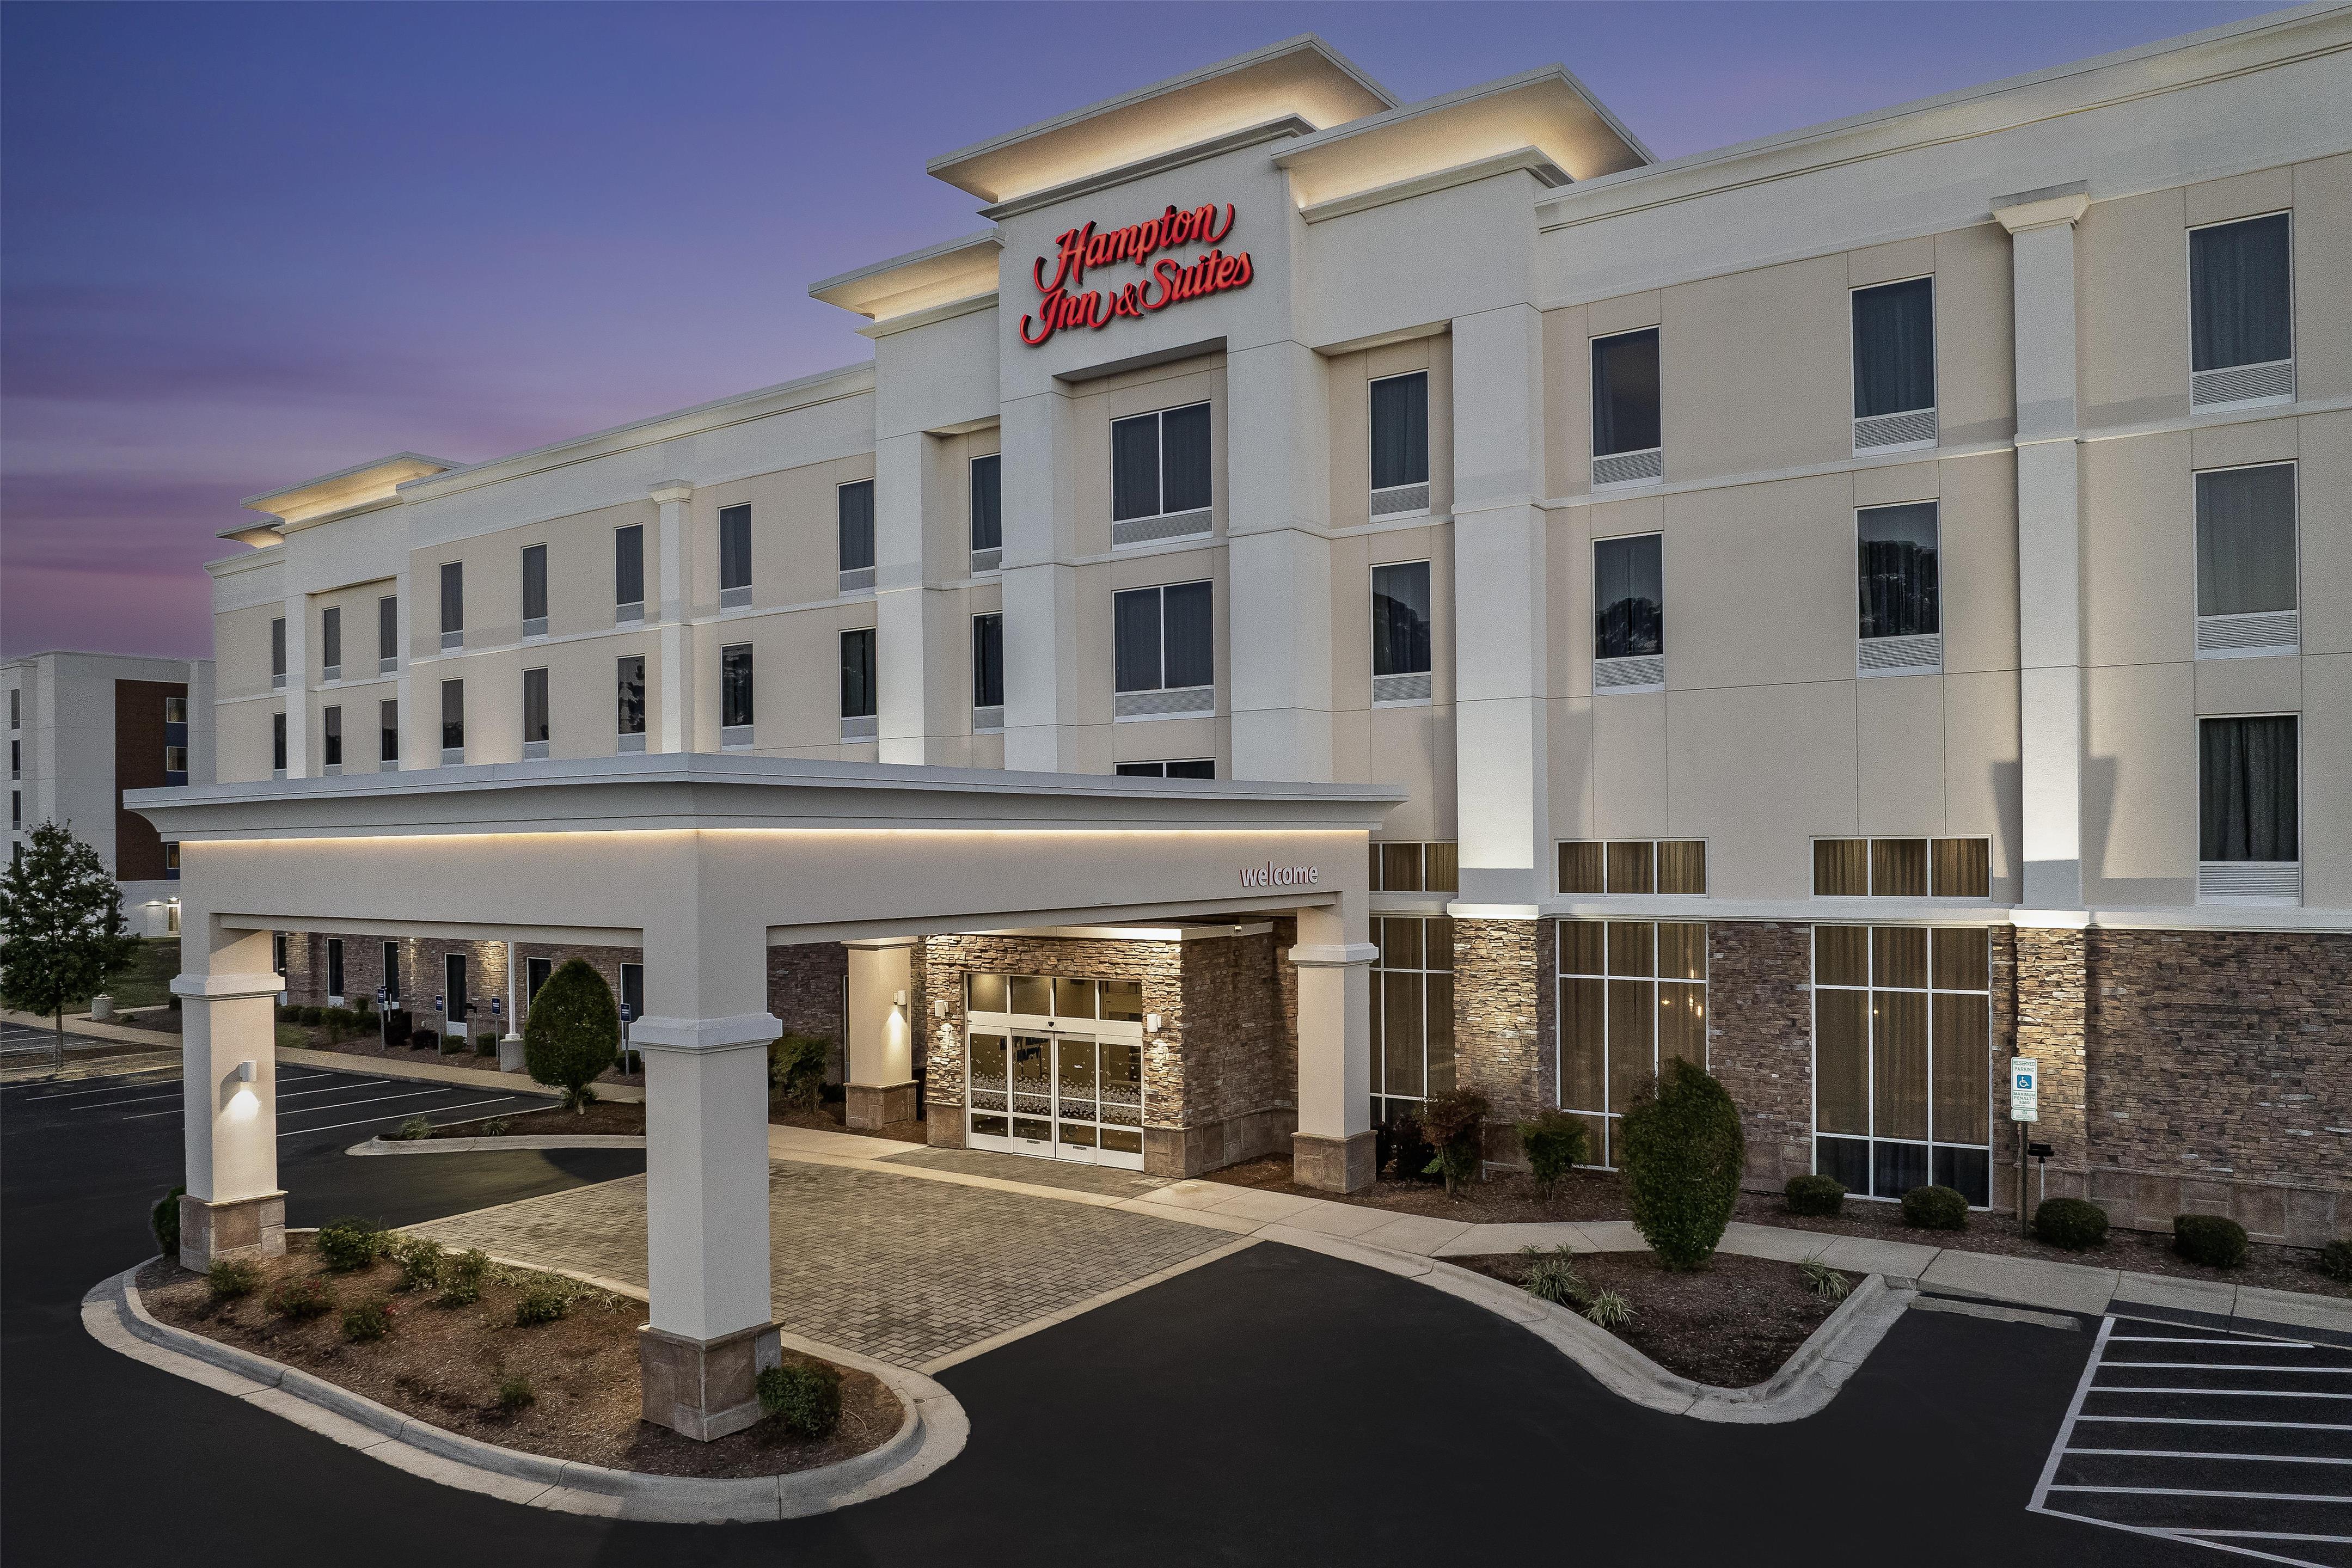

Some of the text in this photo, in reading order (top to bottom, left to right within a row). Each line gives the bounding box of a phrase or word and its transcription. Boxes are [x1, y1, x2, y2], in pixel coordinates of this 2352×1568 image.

[1033, 203, 1235, 293] Hampton
[1020, 249, 1254, 344] Inn & Suites
[1240, 861, 1318, 886] welcome
